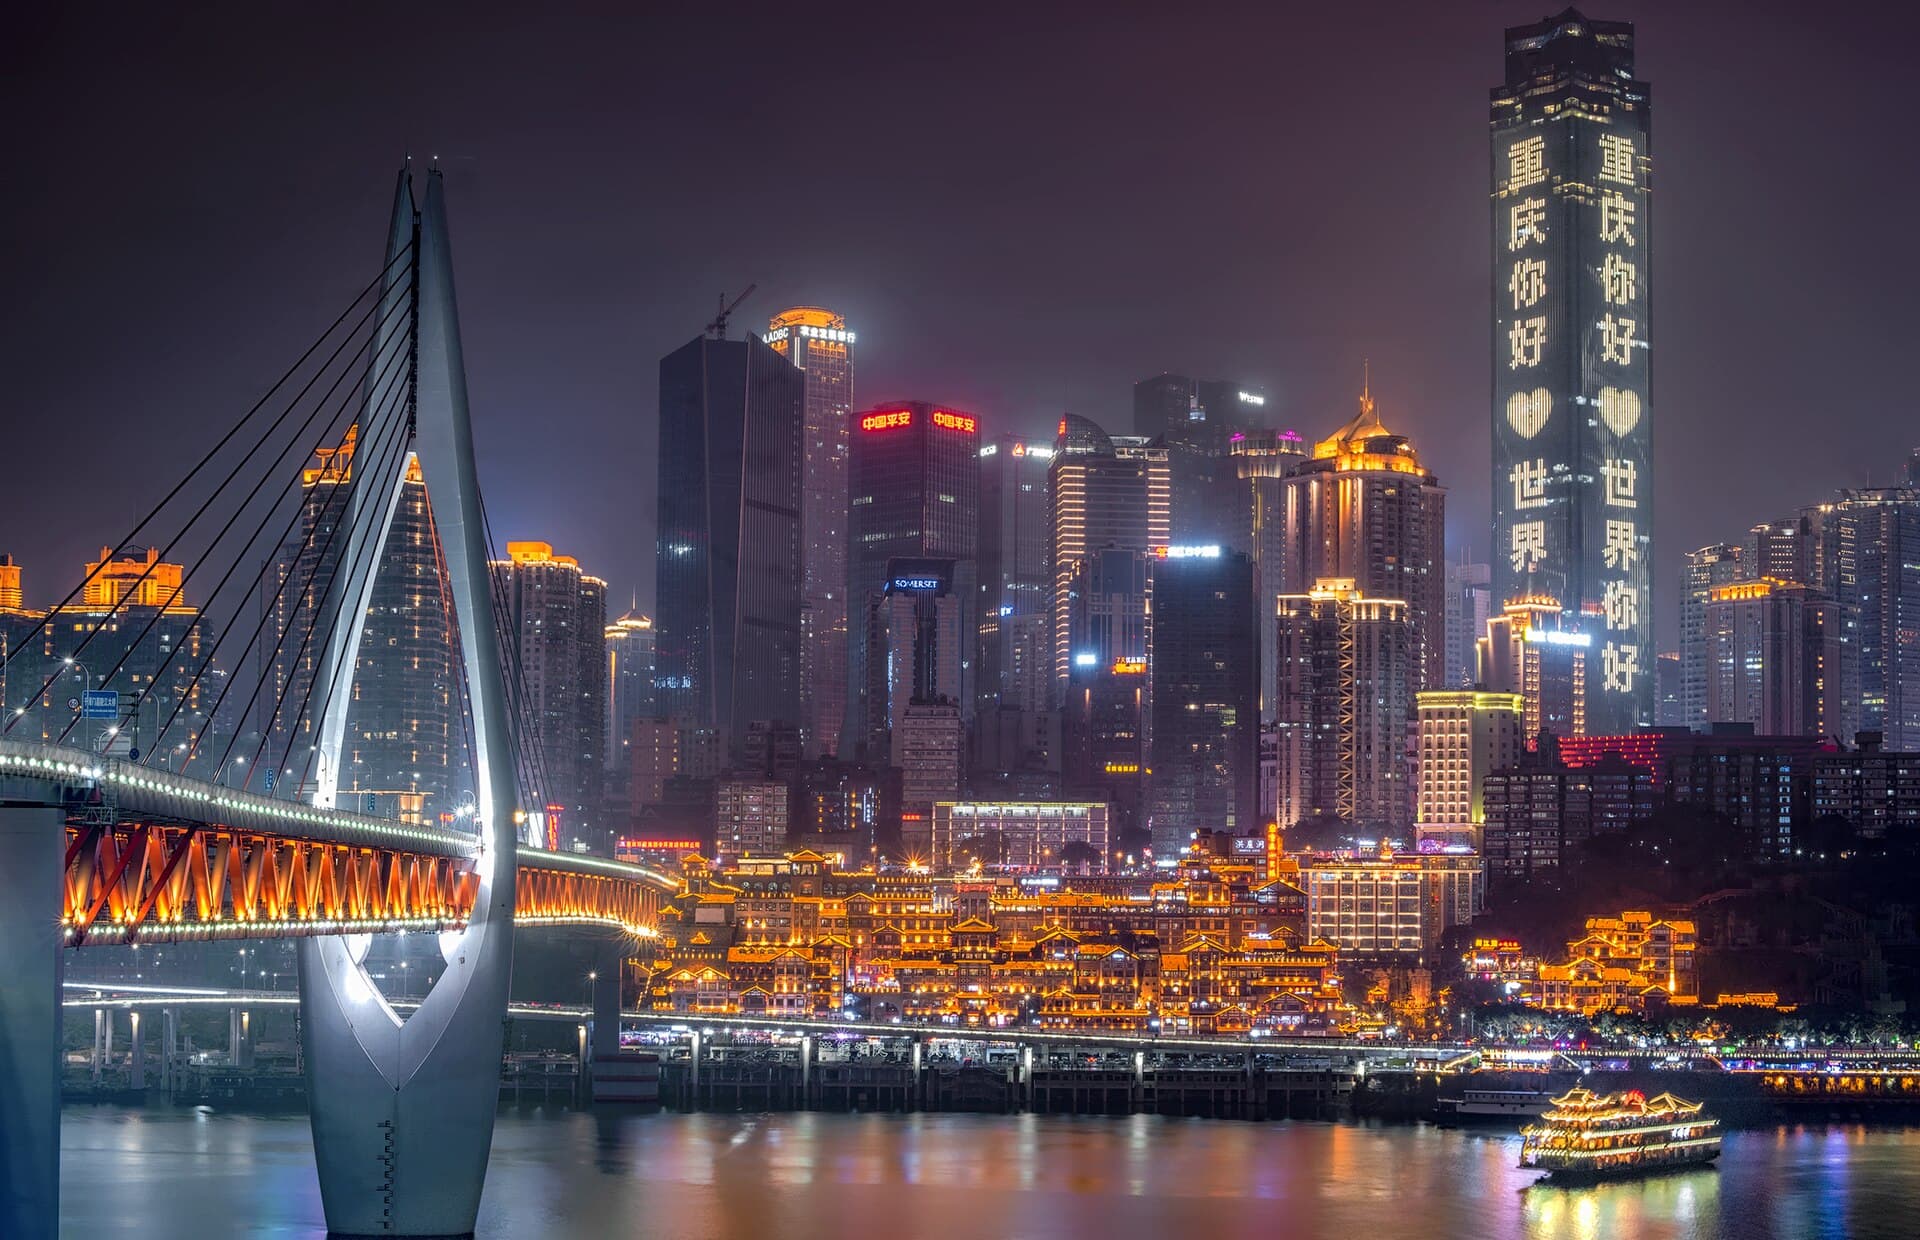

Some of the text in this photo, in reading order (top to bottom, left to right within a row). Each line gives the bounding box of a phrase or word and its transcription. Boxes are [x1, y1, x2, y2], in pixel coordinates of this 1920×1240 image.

[1509, 136, 1547, 573] 重庆你好 世界
[863, 411, 911, 430] 中国平安
[934, 411, 975, 433] 中国平安
[1600, 133, 1637, 692] 重庆你好 世界你好
[895, 579, 938, 588] SOMERSET
[1235, 839, 1265, 849] 洪崖洞
